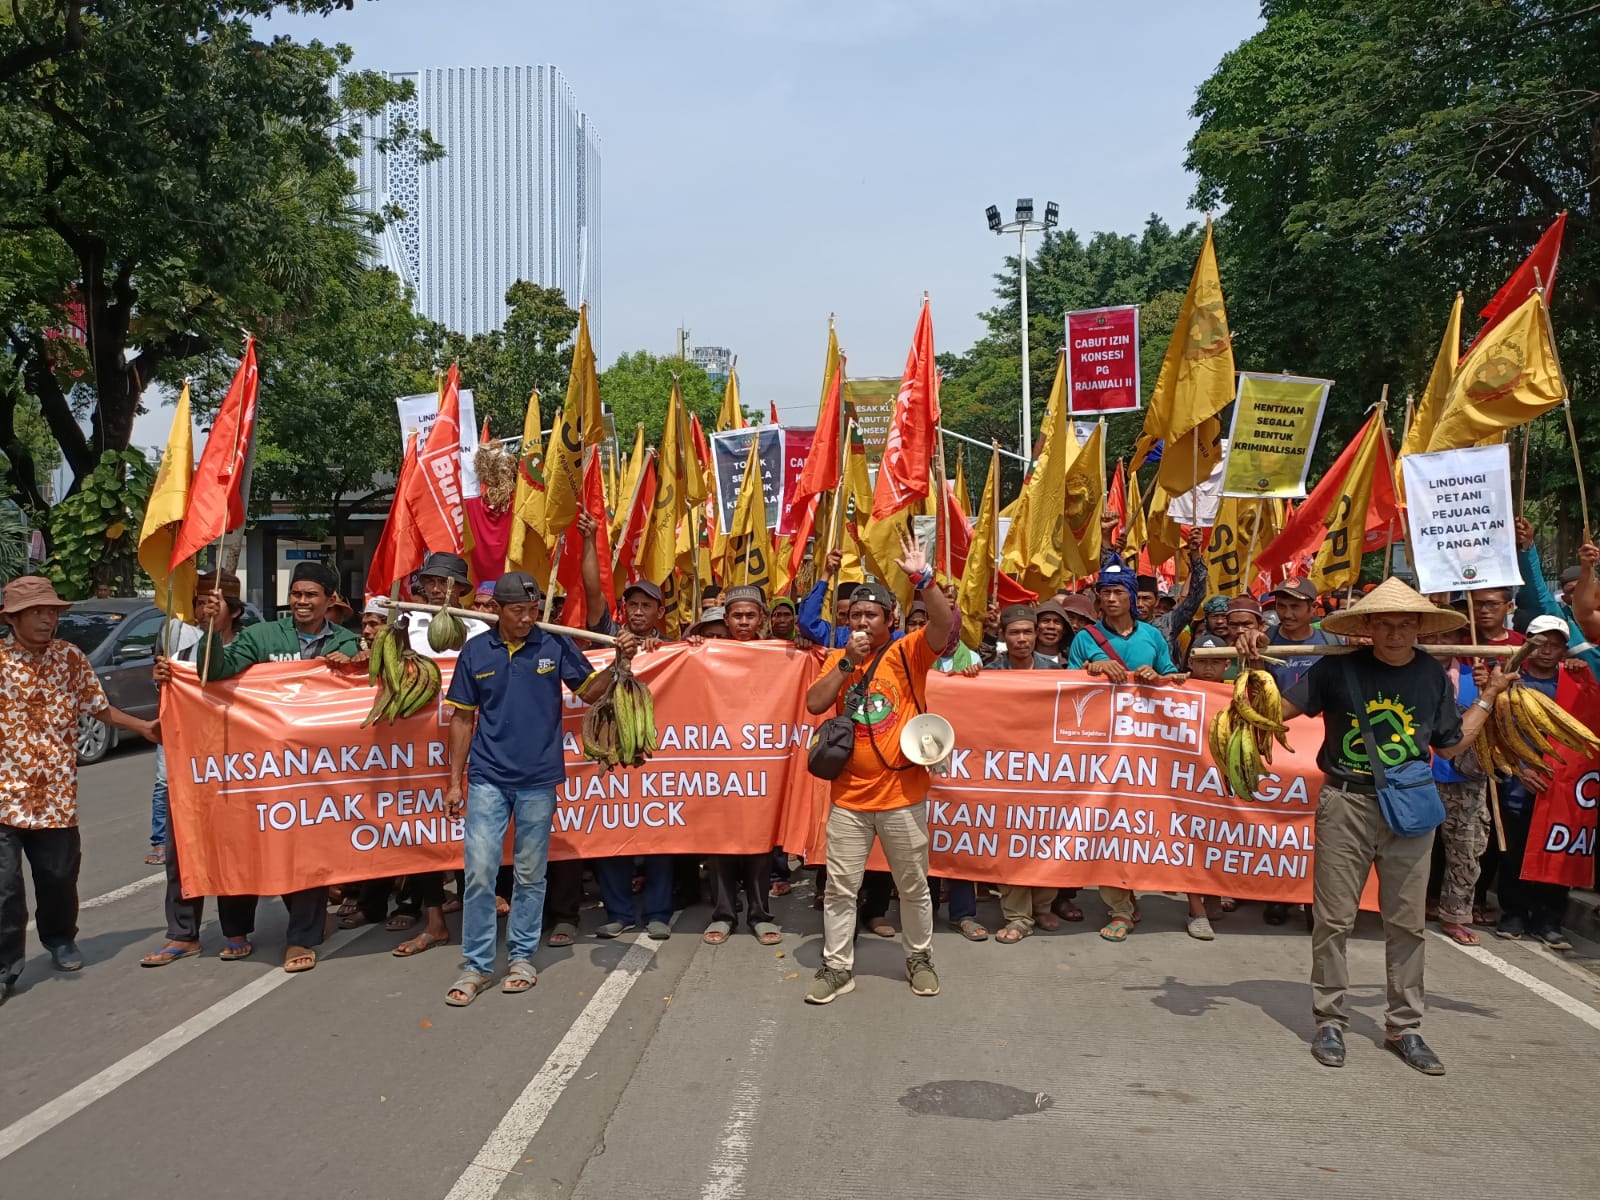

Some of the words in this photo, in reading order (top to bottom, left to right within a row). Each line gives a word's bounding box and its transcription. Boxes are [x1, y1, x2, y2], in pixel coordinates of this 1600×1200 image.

[1074, 337, 1107, 349] CABUT
[1109, 335, 1130, 346] IZIN
[1081, 350, 1124, 363] KONSESI
[1095, 366, 1110, 376] PG
[1075, 378, 1122, 392] RAJAWALI
[1254, 403, 1304, 415] HENTIKAN
[1257, 417, 1295, 427] SEGALA
[1254, 430, 1294, 441] BENTUK
[1234, 441, 1306, 455] KRIMINALISASI
[1429, 474, 1486, 489] LINDUNGI
[1437, 491, 1482, 503] PETANI
[1432, 506, 1491, 519] PEJUANG
[1420, 520, 1505, 536] KEDAULATAN
[1437, 537, 1490, 550] PANGAN
[1208, 524, 1240, 591] SPI
[1116, 691, 1199, 721] Partai
[1114, 715, 1198, 745] Buruh
[190, 742, 415, 784] LAKSANAKAN
[984, 750, 1158, 786] KENAIKAN
[1169, 759, 1309, 804] HAGA
[256, 792, 365, 833] TOLAK
[641, 771, 767, 798] KEMBALI
[1005, 804, 1161, 838] INTIMIDASI,
[1169, 811, 1315, 851] KRIMINAL
[931, 829, 999, 857] DAN
[1007, 833, 1195, 867] DISKRIMINASI
[1204, 846, 1309, 880] PETANI
